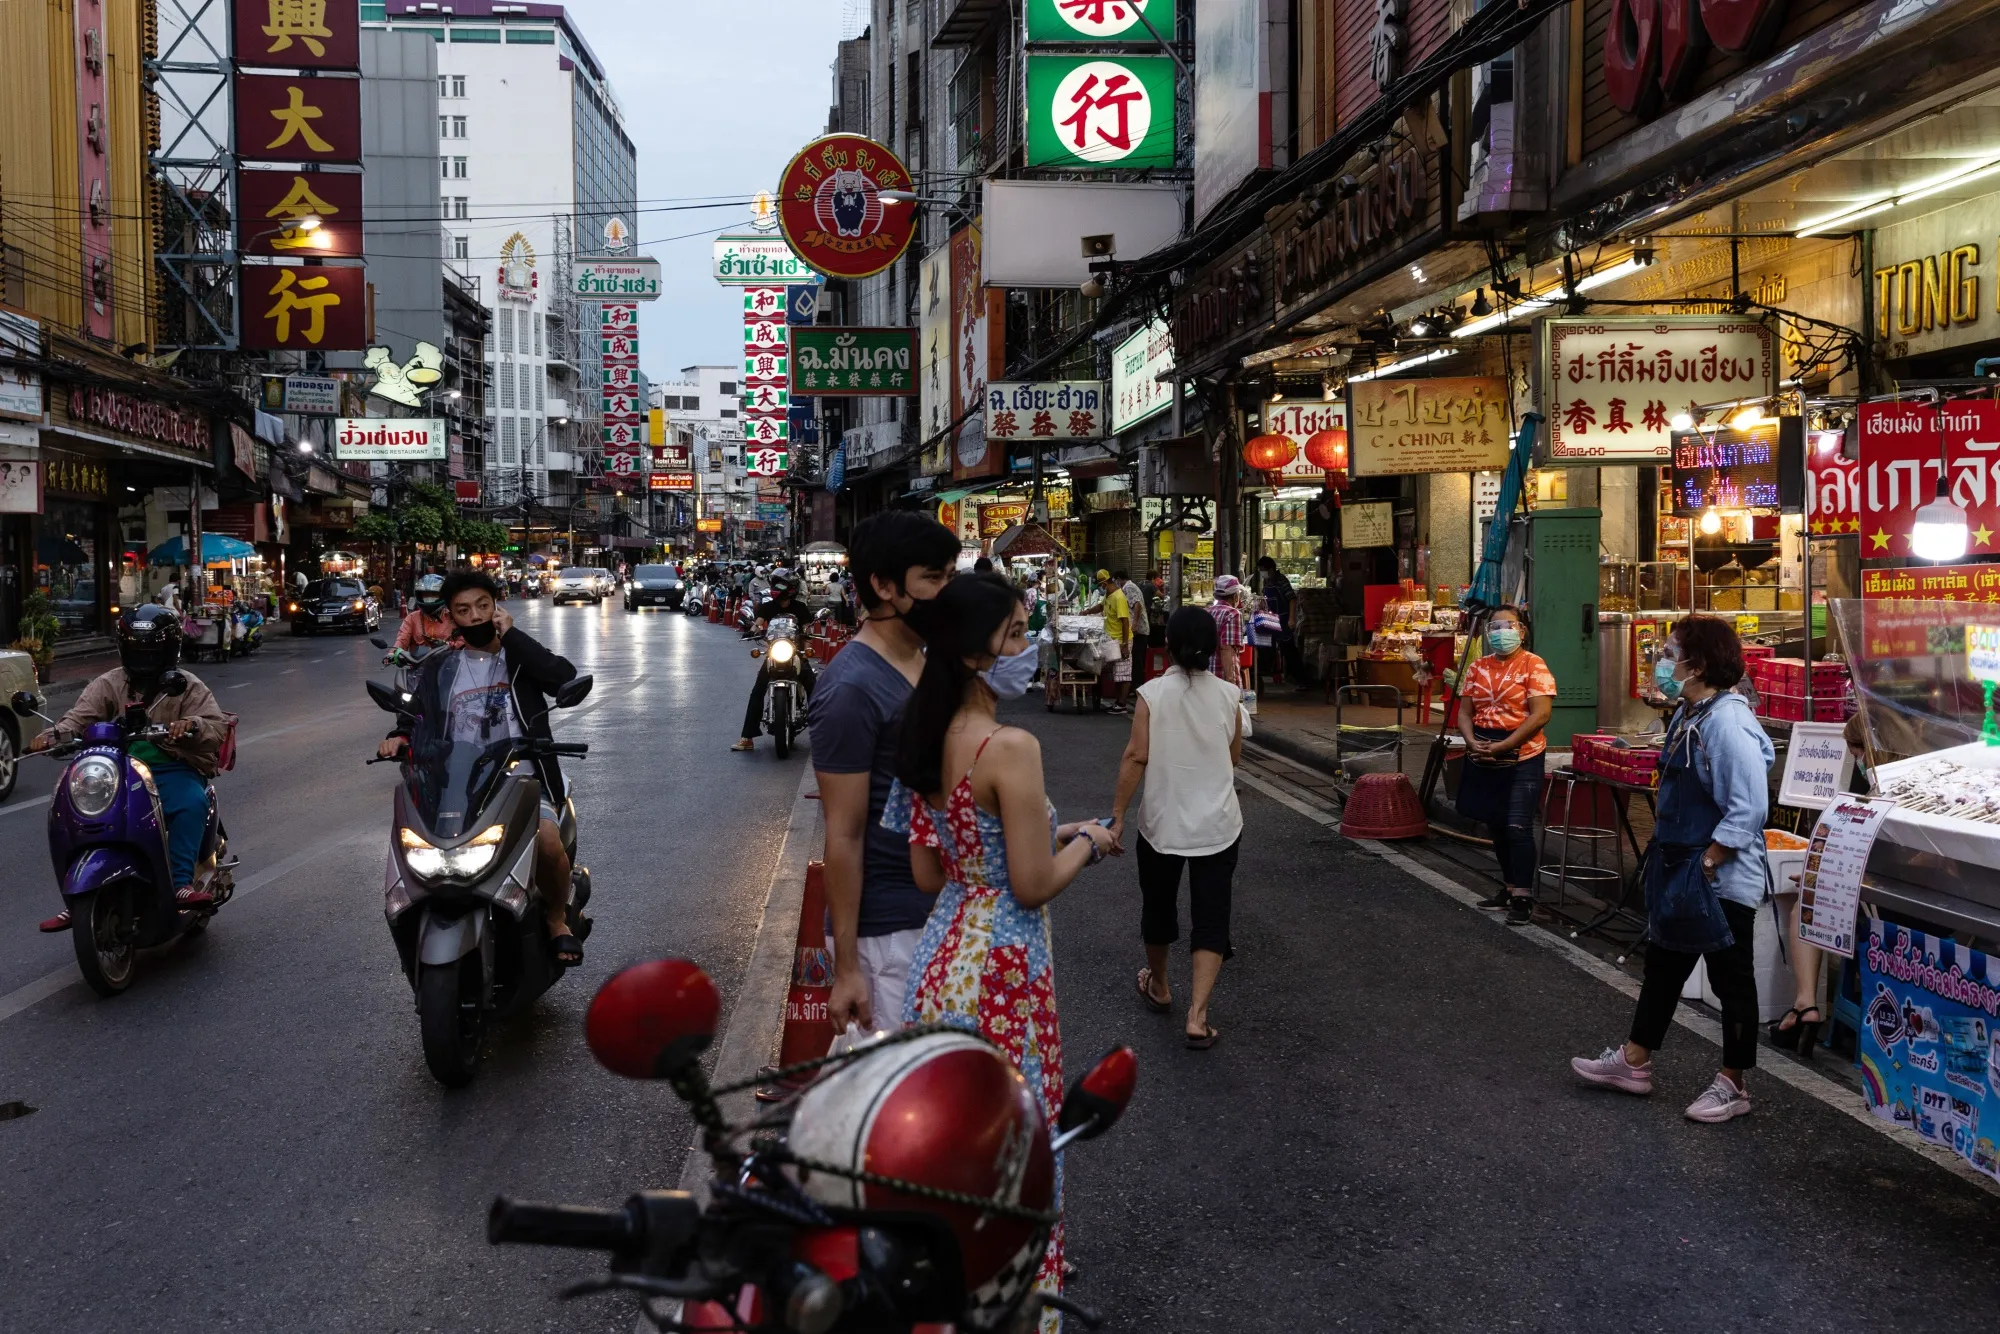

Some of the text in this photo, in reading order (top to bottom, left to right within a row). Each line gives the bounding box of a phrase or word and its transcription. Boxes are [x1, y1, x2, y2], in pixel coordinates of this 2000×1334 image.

[1875, 243, 1979, 340] TONG
[798, 333, 910, 370] ฉ.มั่นคง
[1567, 343, 1754, 385] ฮะกี่ลิ้มจิงเฮียง
[288, 381, 334, 392] แสงอรุณ
[610, 308, 633, 474] 和成興大金行
[754, 291, 778, 474] 和成興大金行
[990, 410, 1097, 437] 蔡益發
[1866, 411, 1922, 435] เฮียเม้ง
[1398, 432, 1454, 448] CHINA
[1922, 569, 1967, 591] เกาลัด
